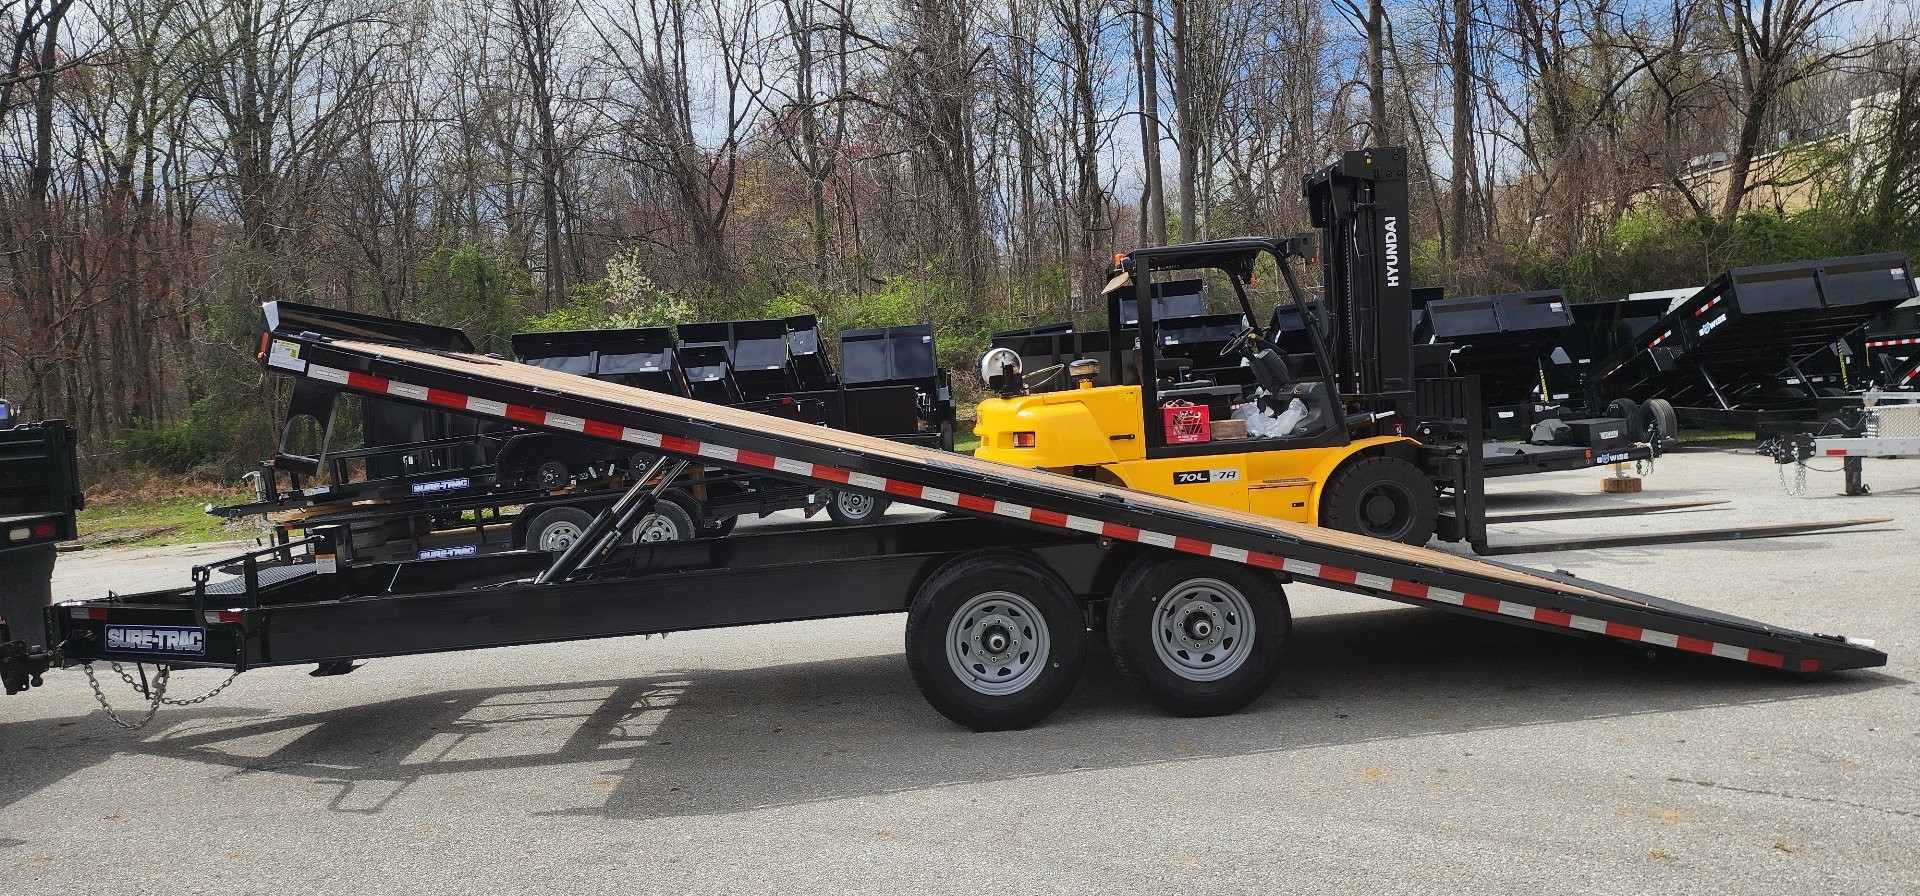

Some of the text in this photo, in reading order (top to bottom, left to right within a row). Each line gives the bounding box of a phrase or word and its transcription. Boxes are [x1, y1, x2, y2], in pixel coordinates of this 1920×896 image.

[1384, 216, 1399, 287] HYUNDAI
[1178, 472, 1208, 483] 70L
[413, 479, 468, 493] SURE-TRAC
[419, 547, 475, 560] SURE-TRAC
[107, 628, 203, 652] SURE-TRAC
